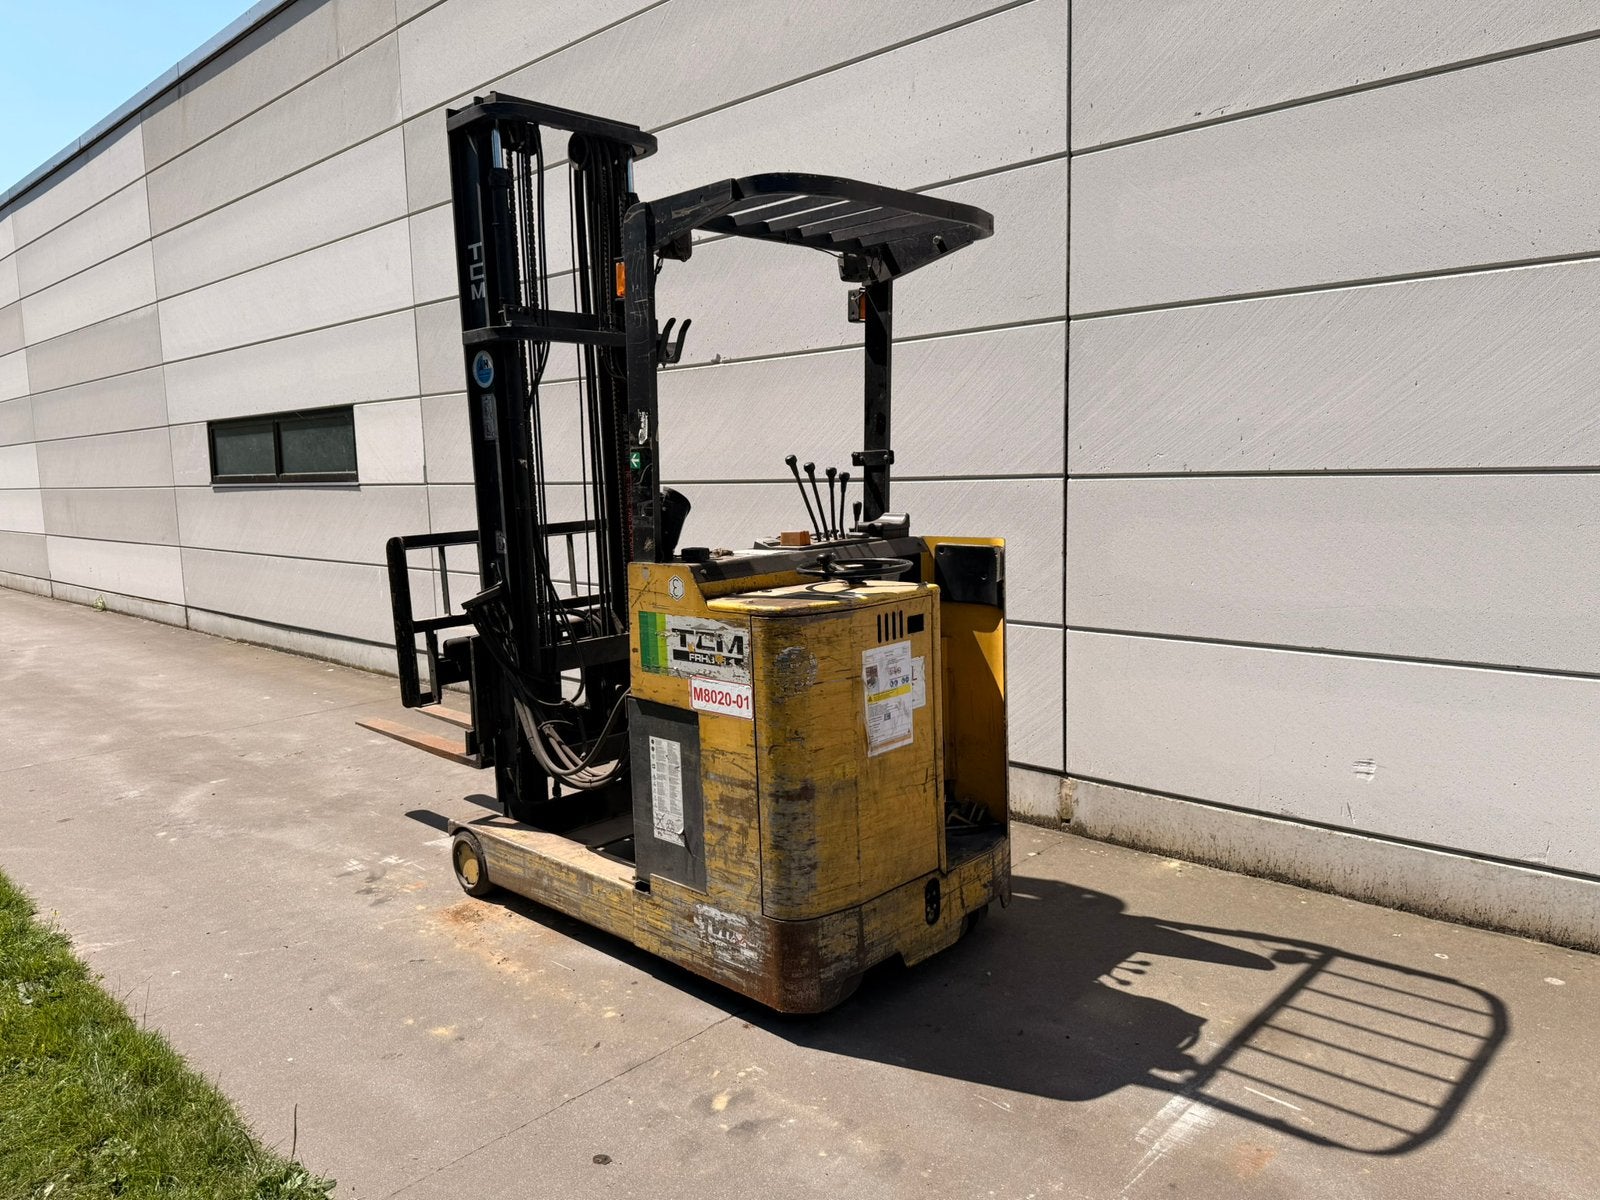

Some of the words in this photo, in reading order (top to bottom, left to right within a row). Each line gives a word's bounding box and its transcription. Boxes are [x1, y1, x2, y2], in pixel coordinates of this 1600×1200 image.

[467, 242, 486, 300] TCM
[671, 627, 744, 656] TCM
[693, 686, 750, 710] M8020-01
